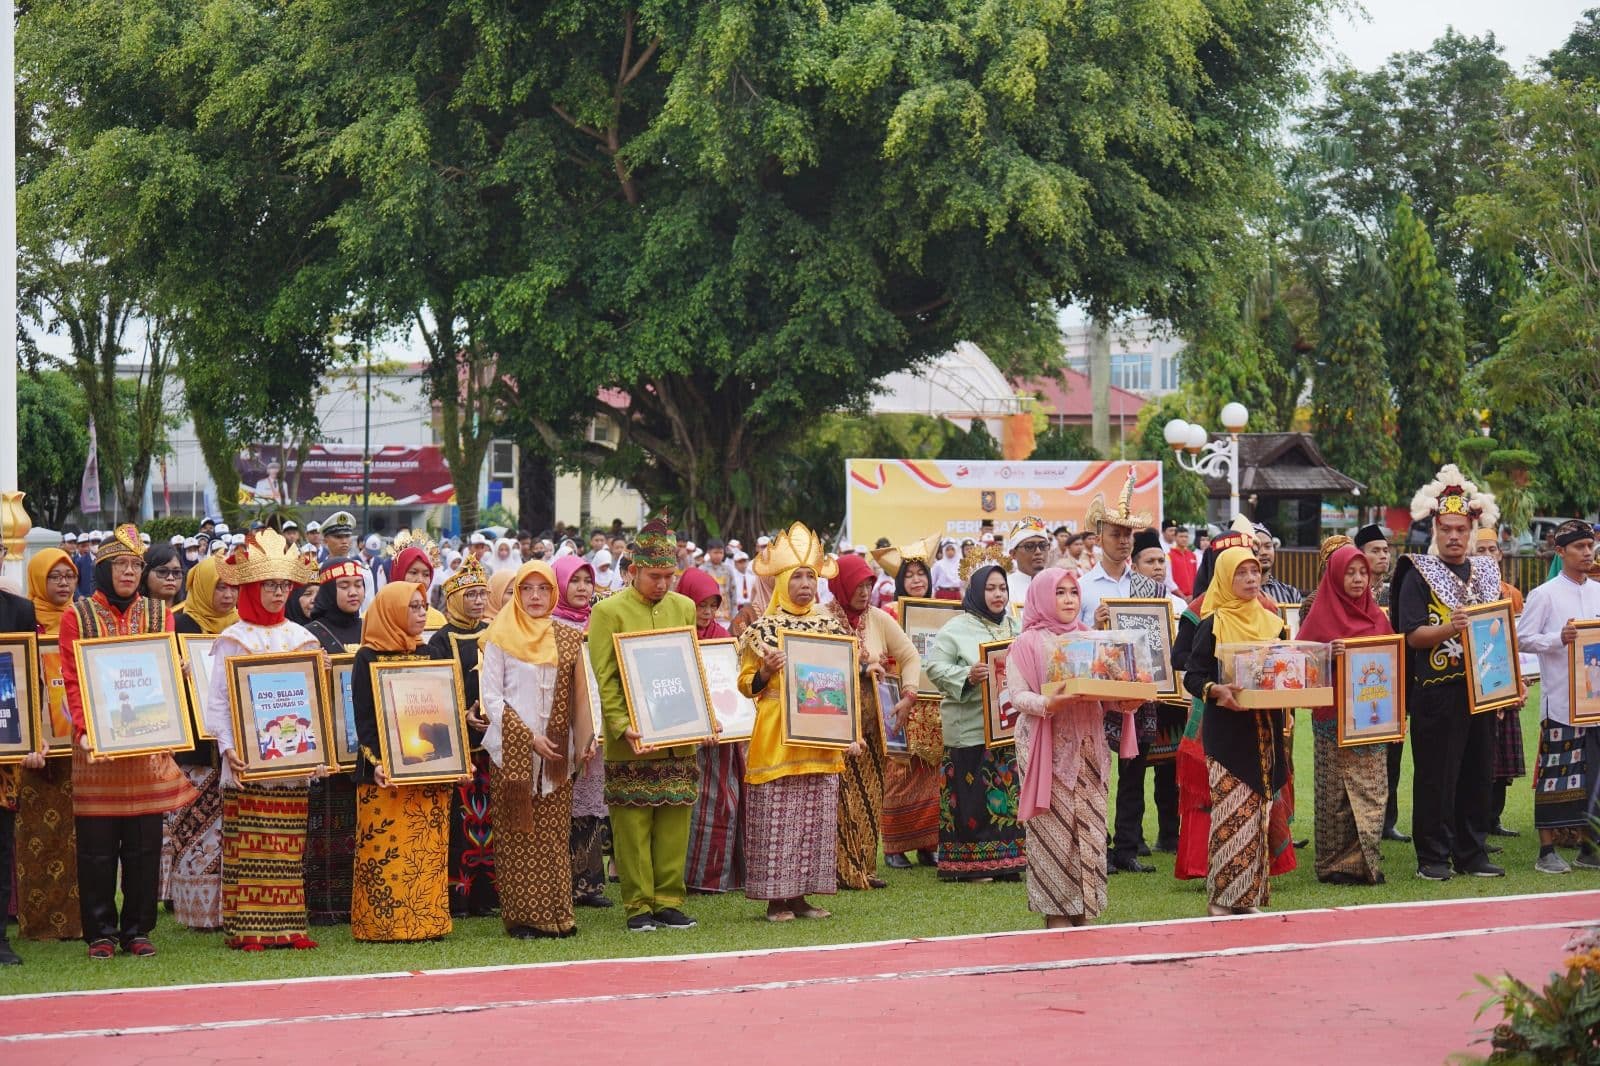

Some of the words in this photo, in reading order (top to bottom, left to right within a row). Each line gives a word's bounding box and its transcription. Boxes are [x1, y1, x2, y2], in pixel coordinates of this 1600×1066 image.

[114, 679, 136, 690] KECIL
[137, 677, 152, 687] CICI
[652, 677, 681, 689] GENG
[276, 689, 305, 698] BELAJAR
[653, 686, 686, 698] HARA
